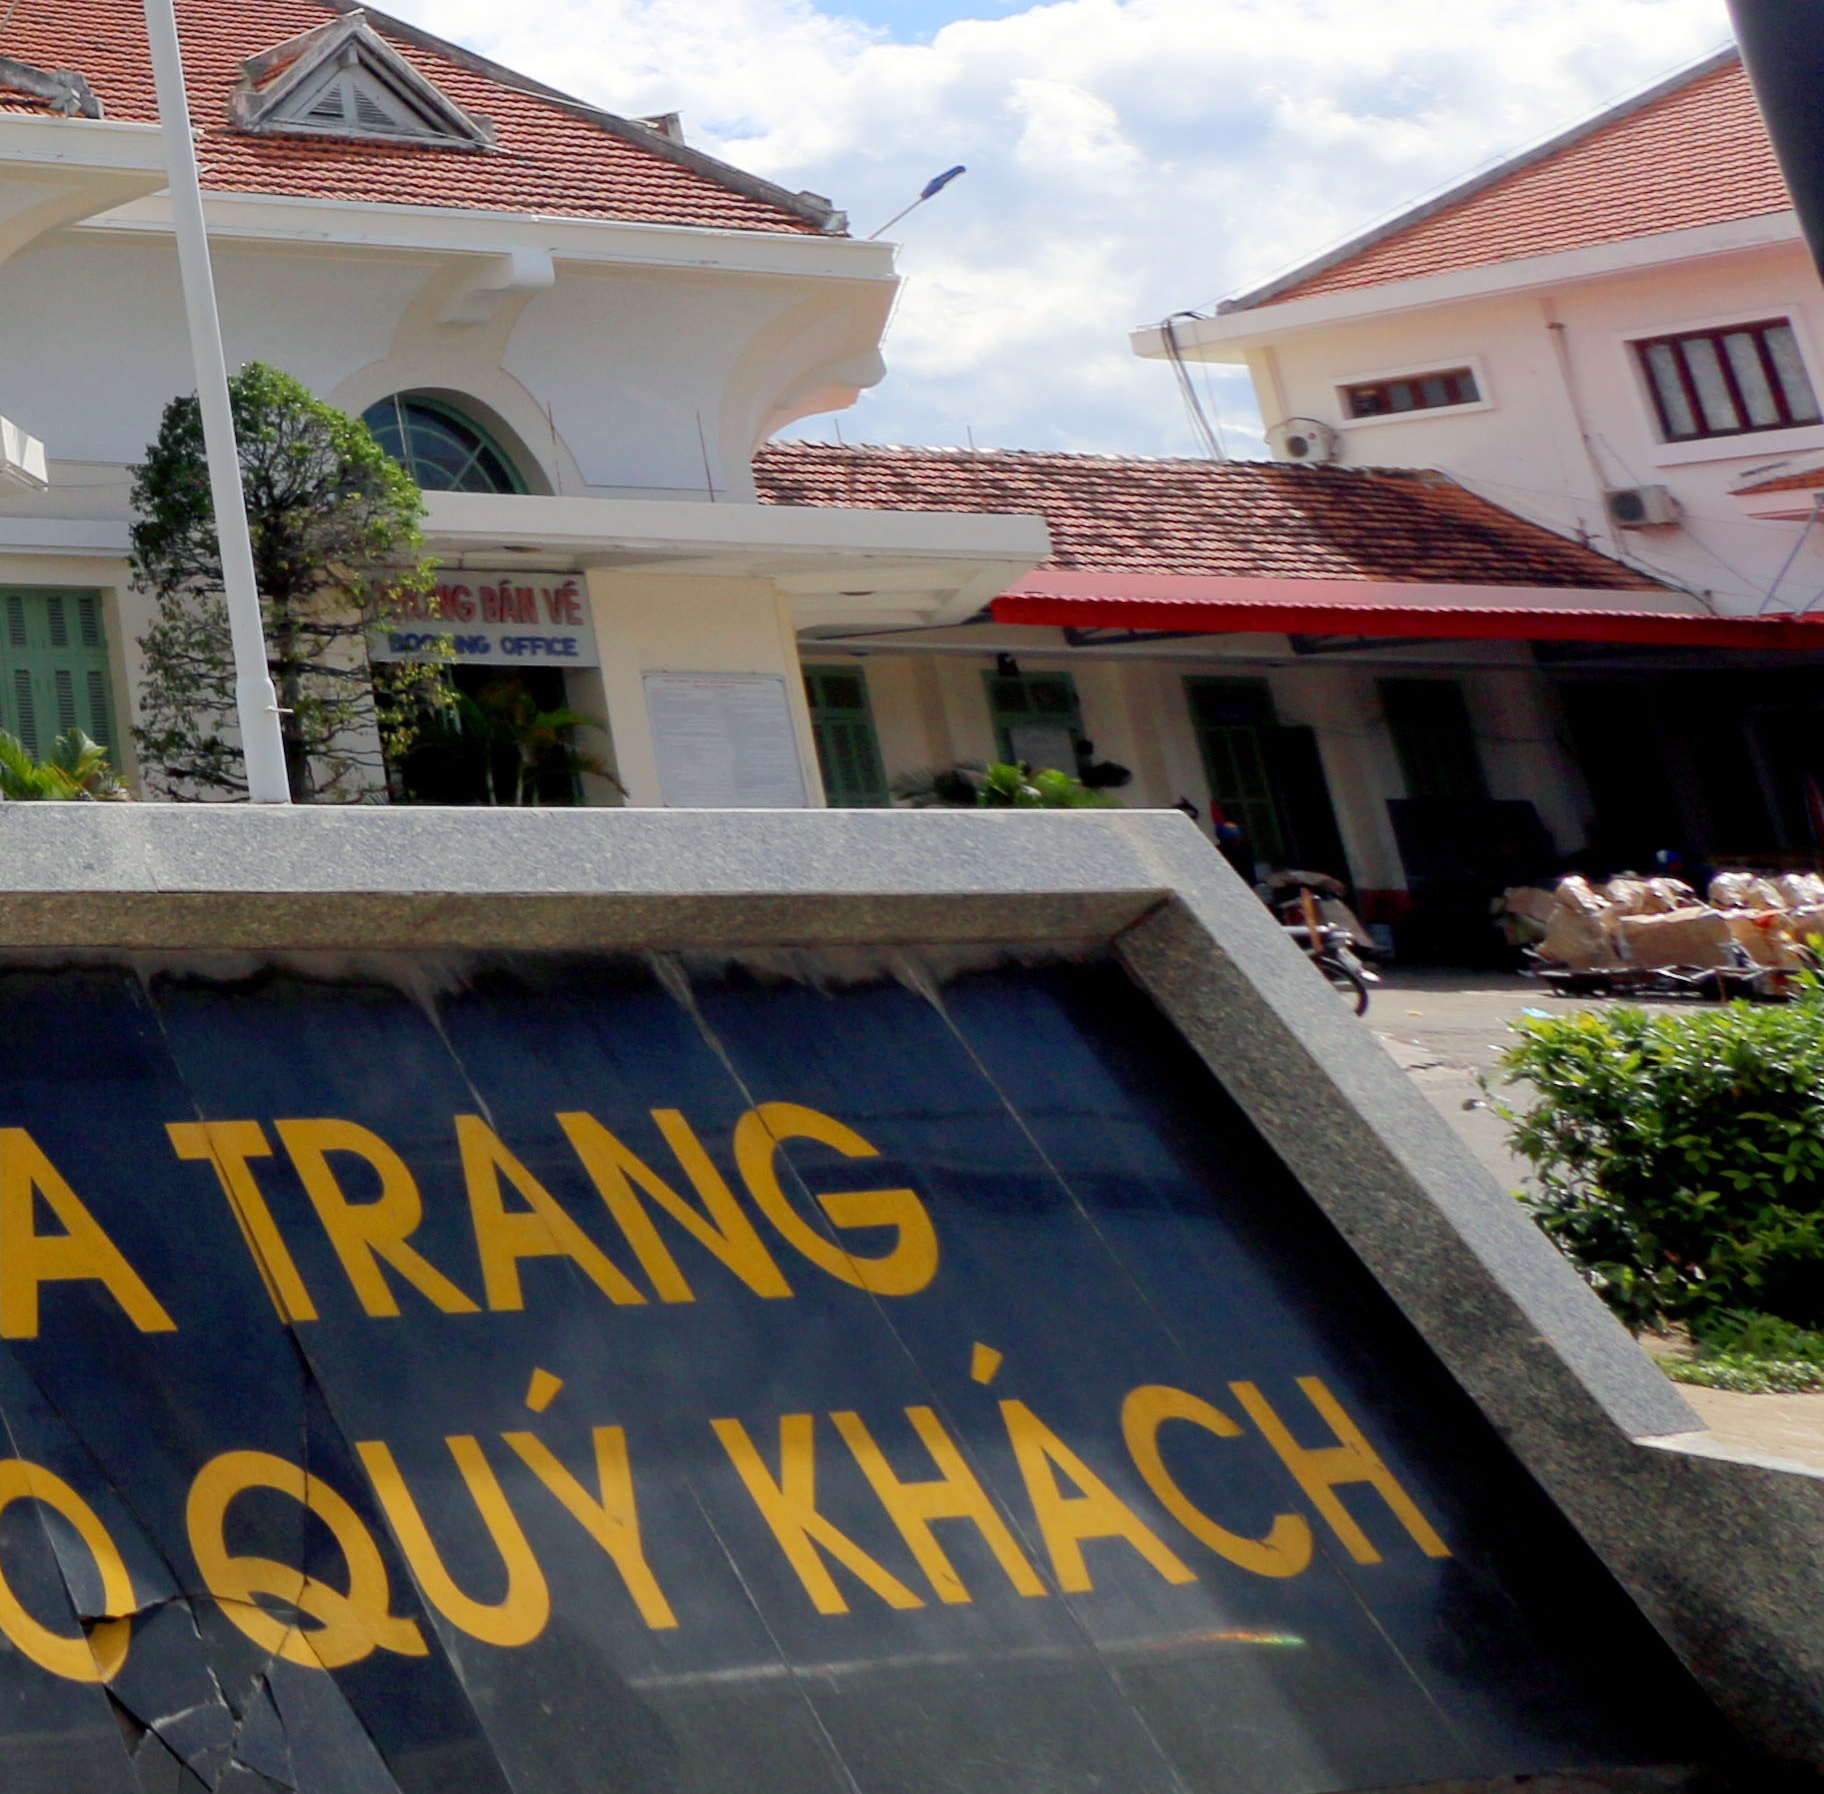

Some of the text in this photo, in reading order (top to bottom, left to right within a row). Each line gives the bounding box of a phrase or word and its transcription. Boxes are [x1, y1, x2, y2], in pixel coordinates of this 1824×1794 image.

[480, 579, 540, 624] BÁN
[499, 635, 580, 657] OFFICE
[164, 1101, 939, 1326] TRANG
[186, 1367, 680, 1670] QUÝ
[709, 1341, 1454, 1616] KHÁCH
